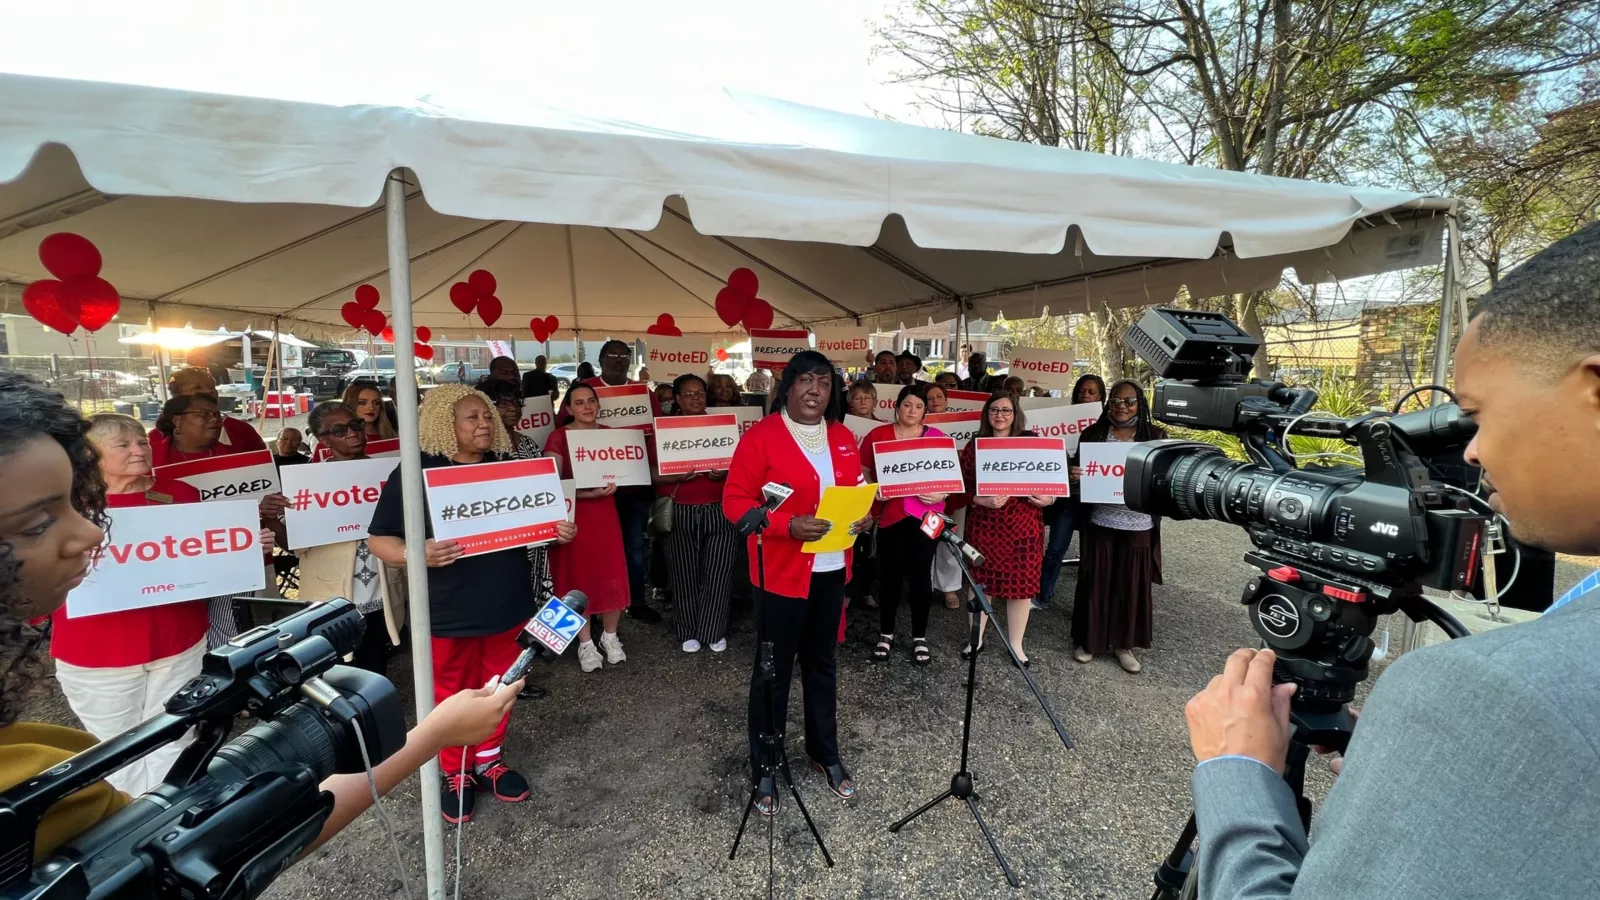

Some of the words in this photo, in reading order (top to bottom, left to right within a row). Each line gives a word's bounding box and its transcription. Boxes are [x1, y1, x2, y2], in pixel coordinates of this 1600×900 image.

[818, 338, 868, 351] #voteED
[649, 348, 709, 364] #voteED
[1012, 357, 1070, 374] #voteED
[596, 405, 648, 420] EDFORED
[662, 437, 735, 451] #REDFORED
[575, 445, 645, 462] #voteED
[882, 460, 955, 474] #REDFORED
[982, 460, 1062, 473] #REDFORED
[201, 478, 272, 502] DFORED
[294, 480, 387, 512] #vote
[442, 491, 556, 521] #REDFORED
[922, 513, 940, 538] 16
[1369, 521, 1400, 537] JVC
[494, 532, 536, 543] EDUCATORS
[538, 527, 555, 535] UNIT
[548, 605, 582, 641] 12
[528, 620, 566, 651] NEWS
